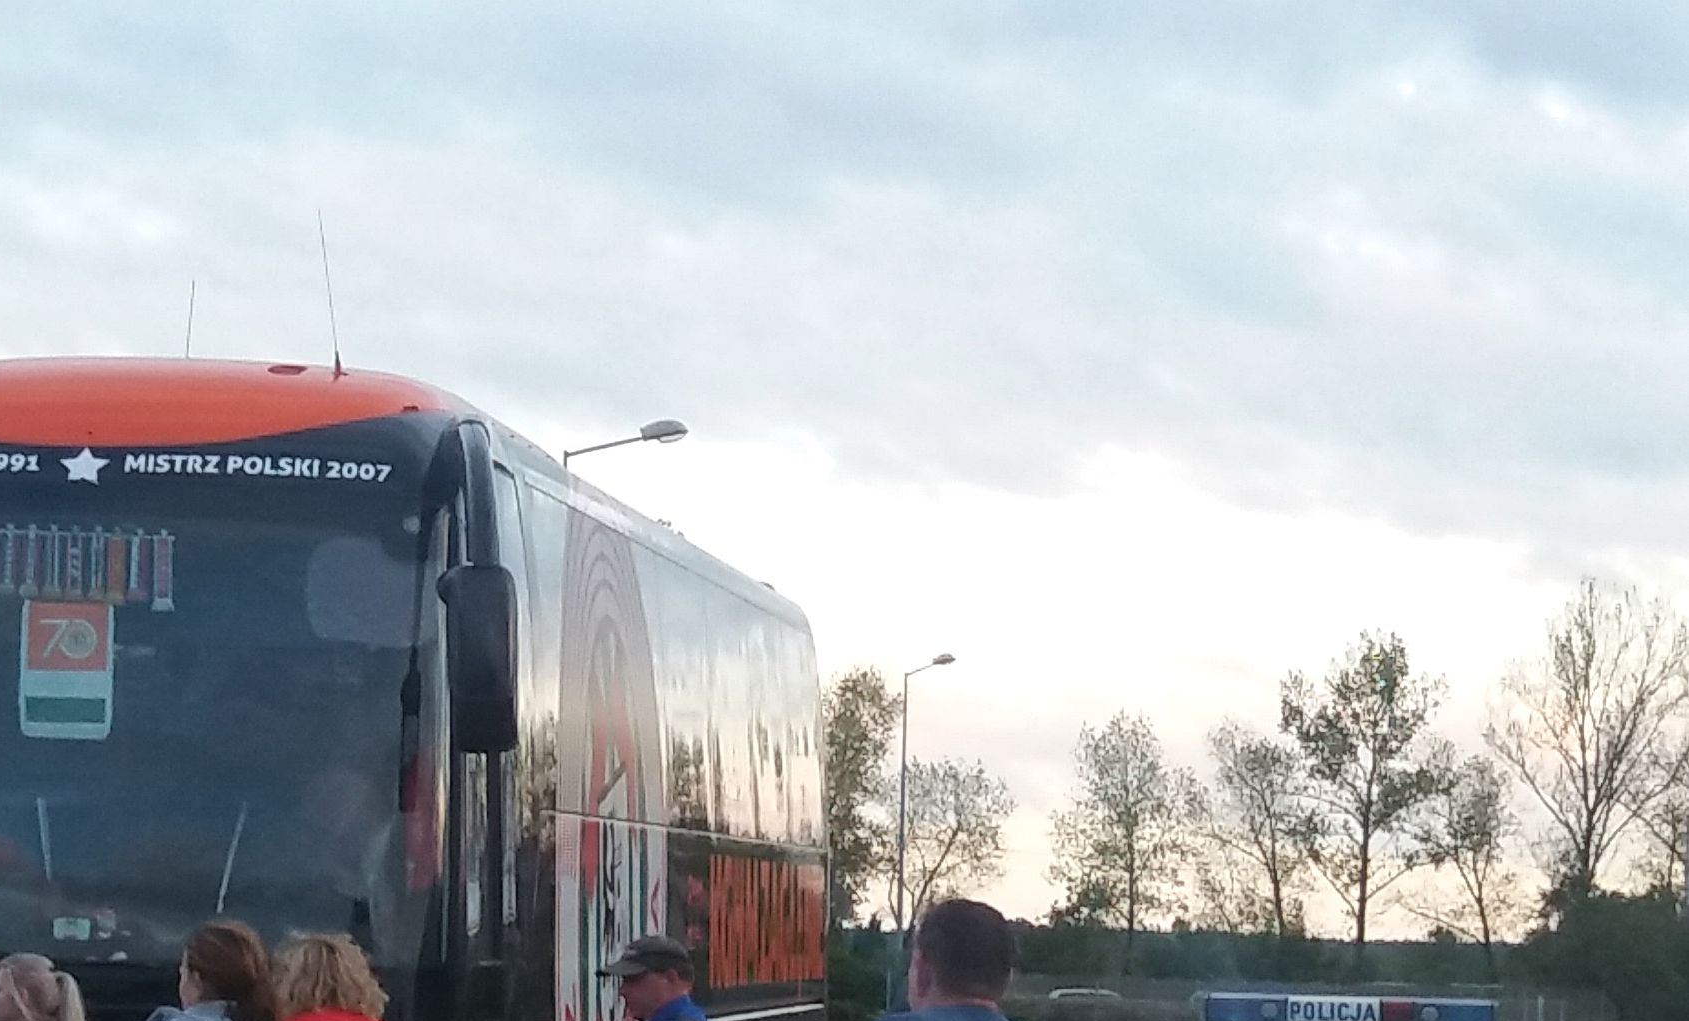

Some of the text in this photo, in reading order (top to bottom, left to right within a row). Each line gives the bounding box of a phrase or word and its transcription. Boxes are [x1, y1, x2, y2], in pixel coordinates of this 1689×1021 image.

[123, 453, 393, 483] MISTRZ POLSKI 2007
